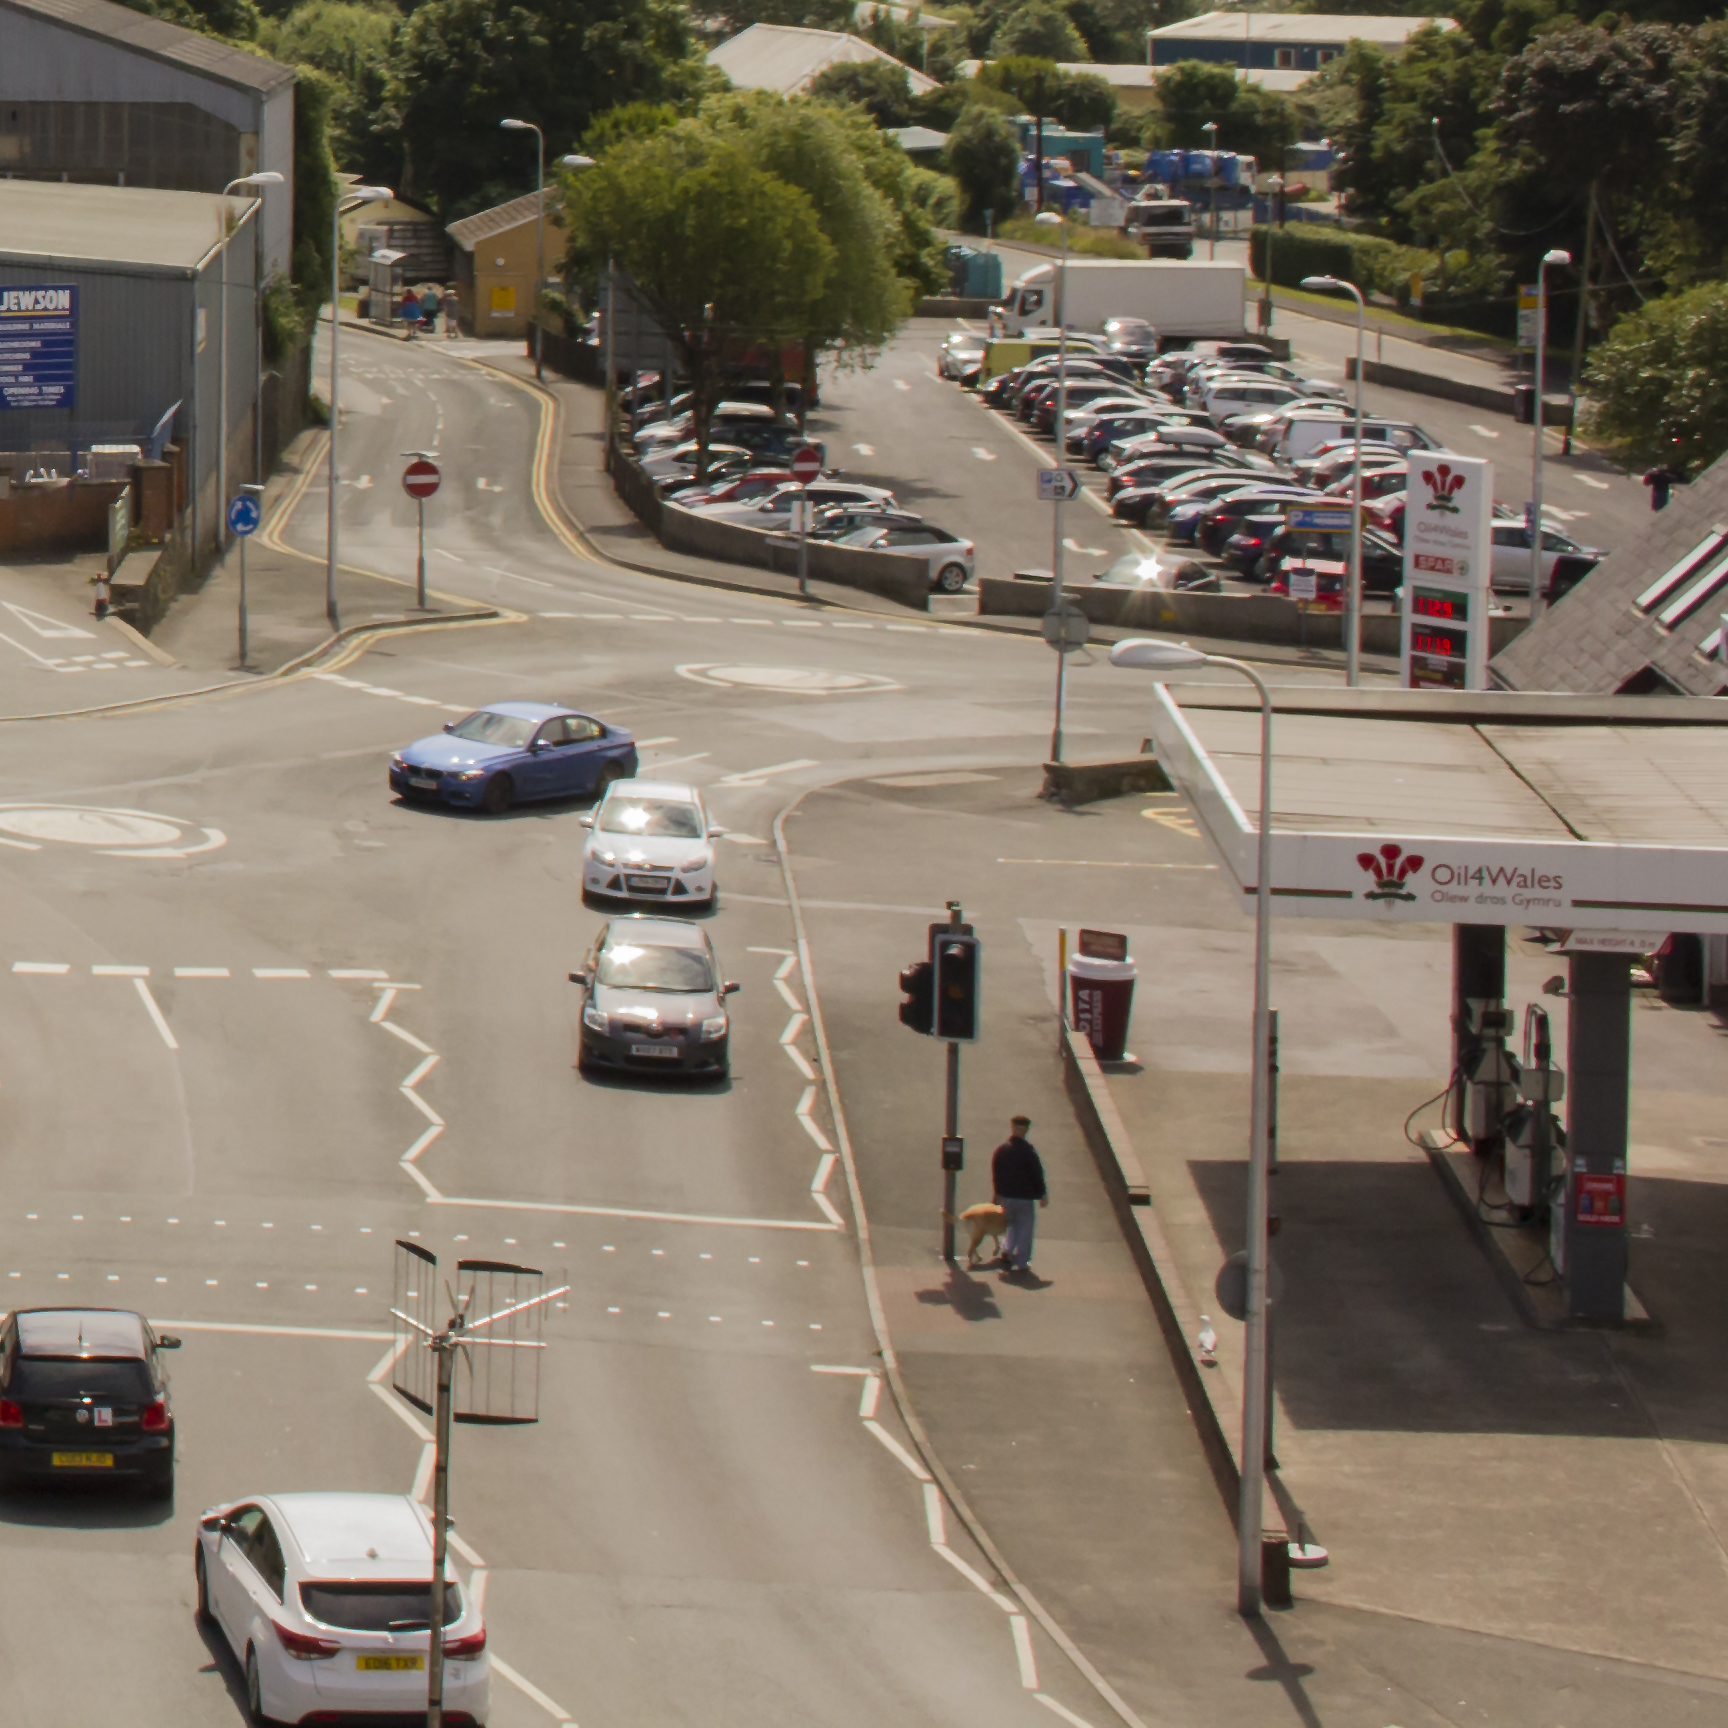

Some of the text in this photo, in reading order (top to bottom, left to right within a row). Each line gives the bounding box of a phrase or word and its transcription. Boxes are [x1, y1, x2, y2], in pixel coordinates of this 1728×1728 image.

[0, 289, 71, 311] JEWSON
[32, 322, 71, 330] MATERIALS
[3, 385, 65, 395] OPENING TIMES
[1416, 521, 1469, 541] Oil4Wales
[1418, 556, 1454, 573] SPAR
[1430, 863, 1564, 890] Oil4Wales
[1430, 889, 1562, 910] Olew dros Gymru
[1574, 936, 1595, 946] MAX
[1597, 937, 1627, 948] HEIGHT
[98, 1409, 109, 1423] L
